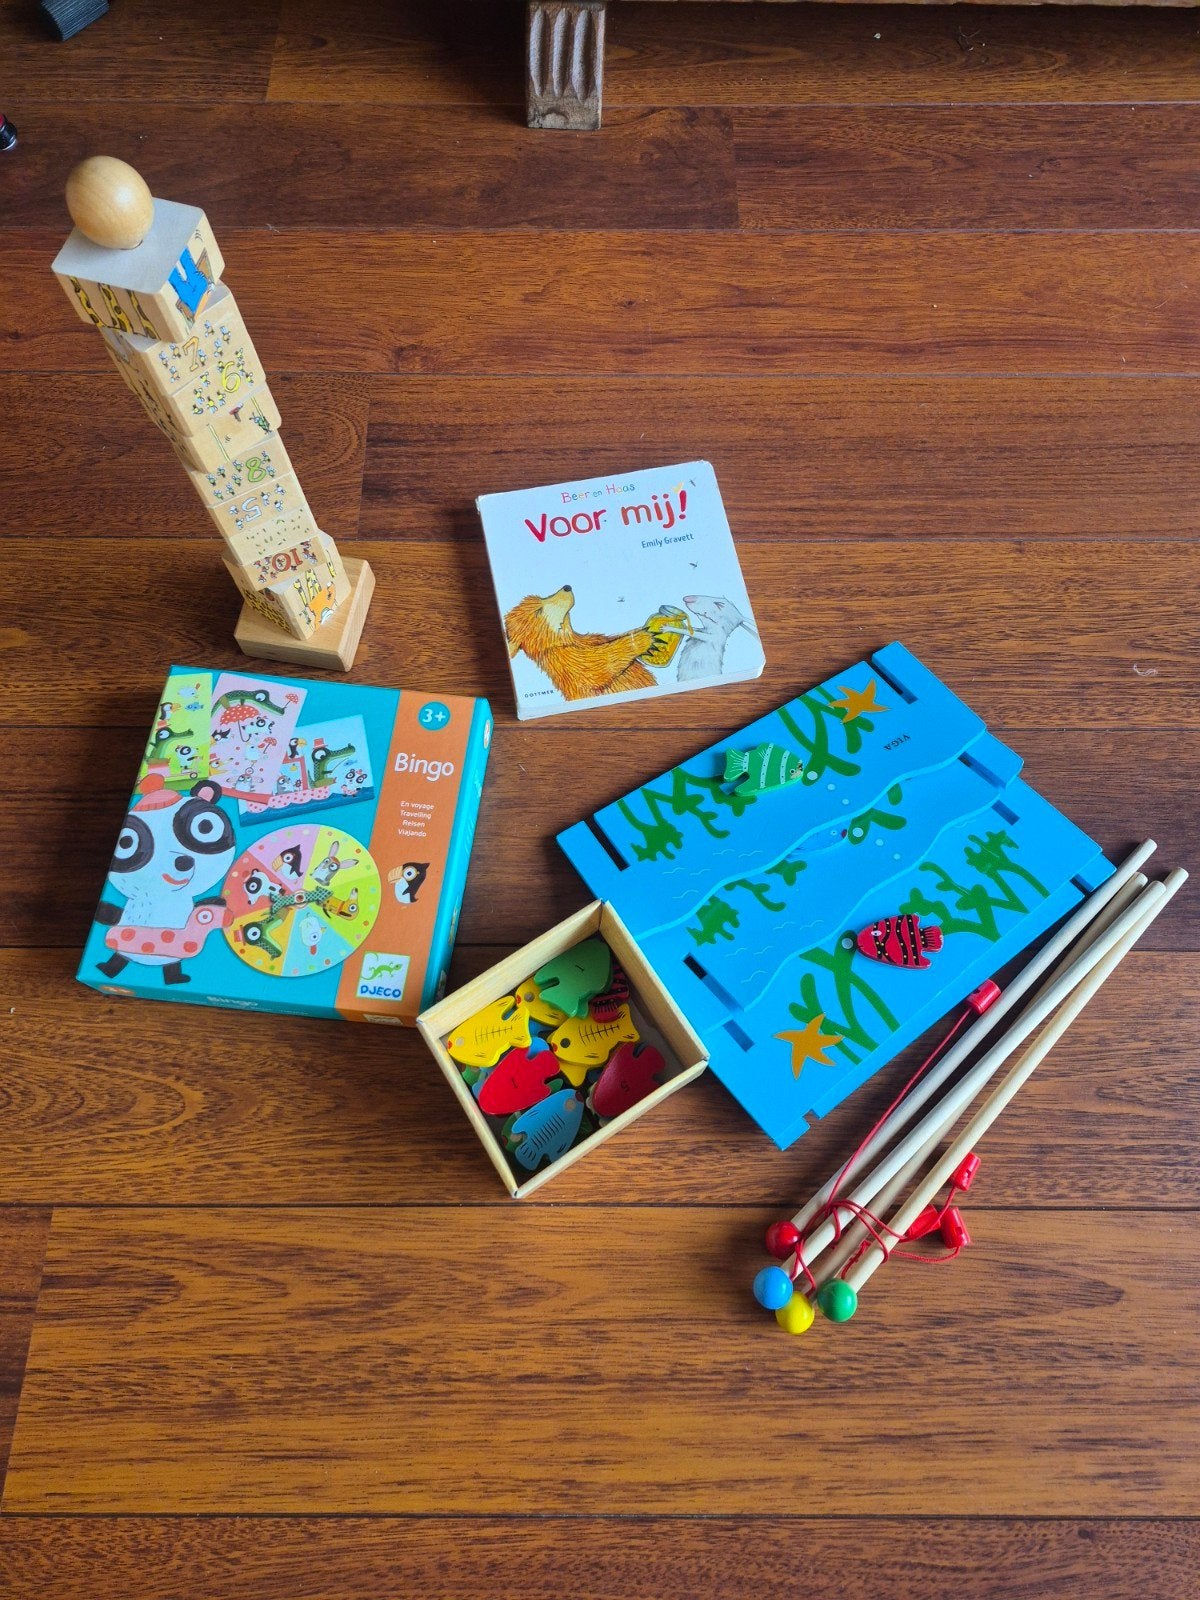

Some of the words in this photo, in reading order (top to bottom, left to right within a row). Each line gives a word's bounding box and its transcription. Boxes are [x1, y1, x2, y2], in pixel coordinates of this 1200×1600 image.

[182, 335, 199, 372] 7
[245, 457, 267, 482] 8
[561, 491, 590, 504] Beer
[593, 490, 603, 498] en
[606, 482, 636, 496] Haas
[241, 496, 262, 522] 5
[524, 509, 607, 543] Voor
[620, 490, 687, 529] mij!
[641, 538, 663, 549] Emily
[664, 533, 694, 545] Gravett
[271, 548, 303, 572] 10
[422, 708, 446, 722] 3+
[394, 752, 455, 781] Bingo
[400, 809, 432, 820] Travelling
[411, 802, 435, 811] voyage
[398, 828, 427, 838] Viajando
[402, 819, 426, 828] Reisen
[360, 985, 402, 998] DJECO
